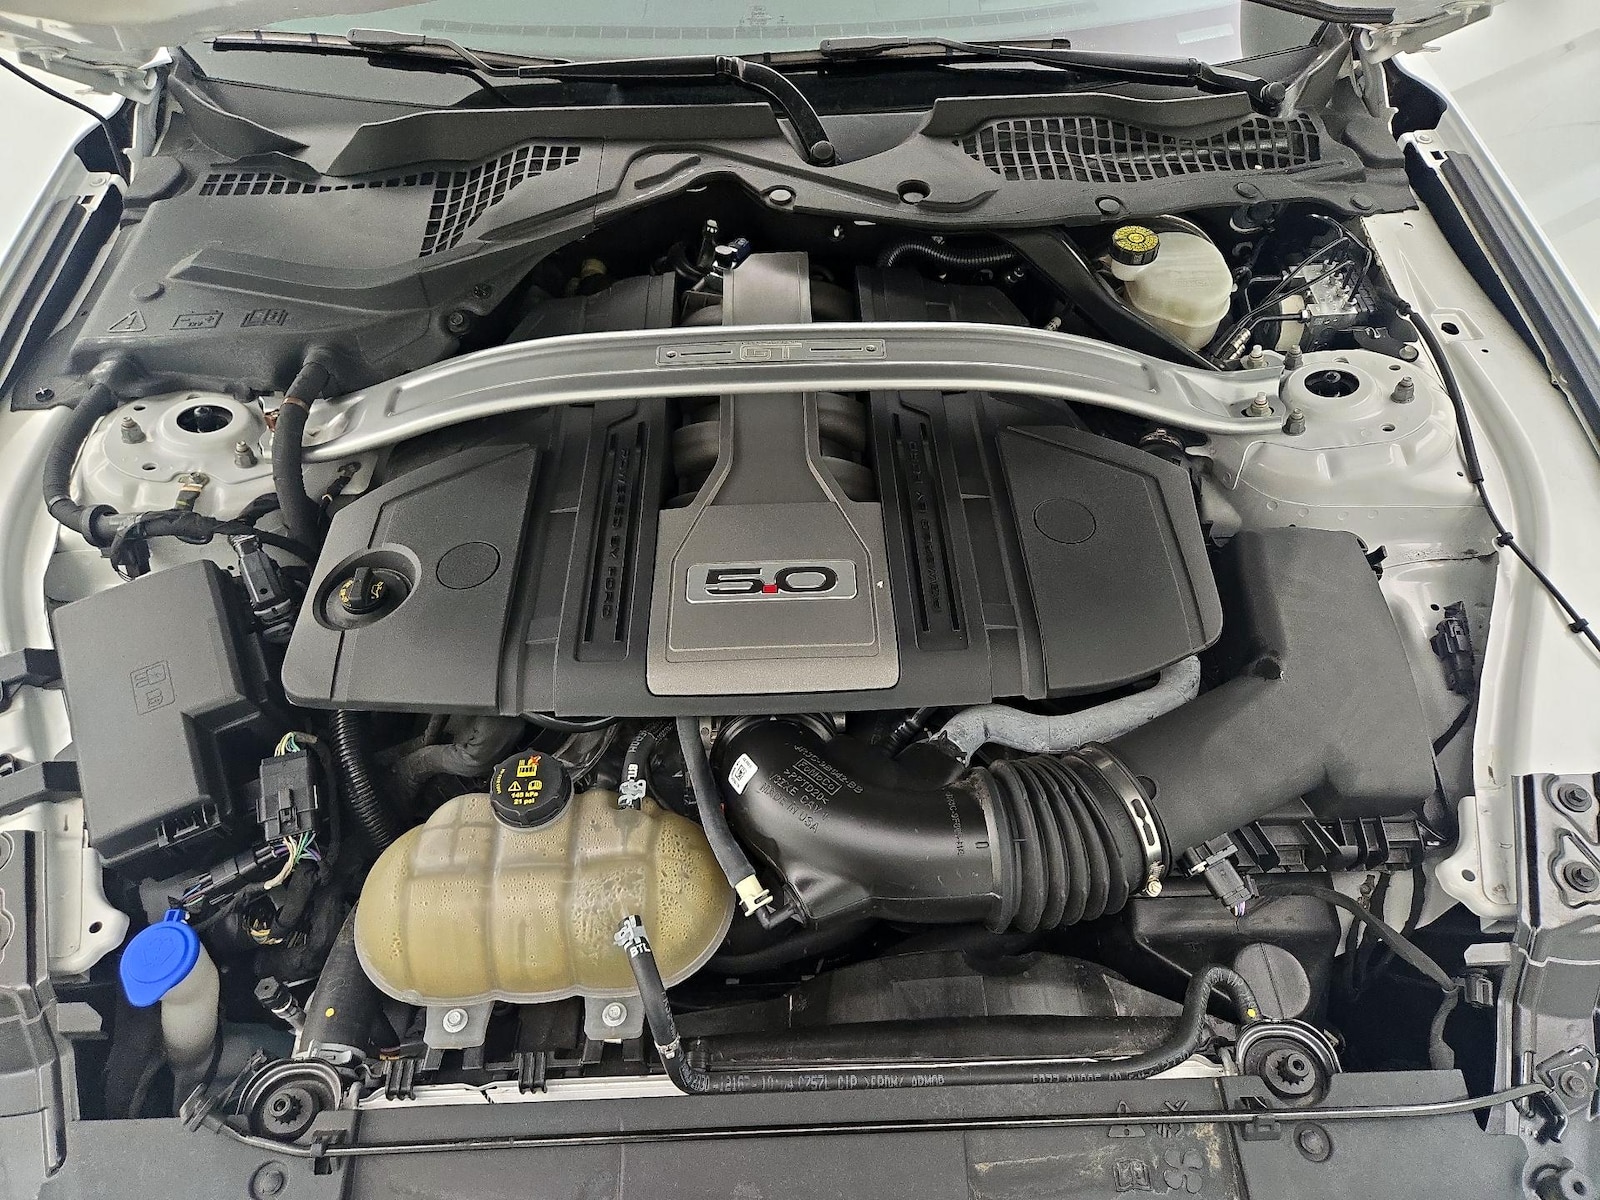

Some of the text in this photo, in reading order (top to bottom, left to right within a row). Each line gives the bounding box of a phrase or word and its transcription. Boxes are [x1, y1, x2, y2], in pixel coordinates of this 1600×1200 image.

[739, 343, 802, 360] GT
[704, 566, 839, 597] 5.0
[798, 761, 835, 791] FoMoCo
[786, 801, 799, 815] IN
[799, 811, 820, 834] USA
[629, 941, 651, 959] BTL
